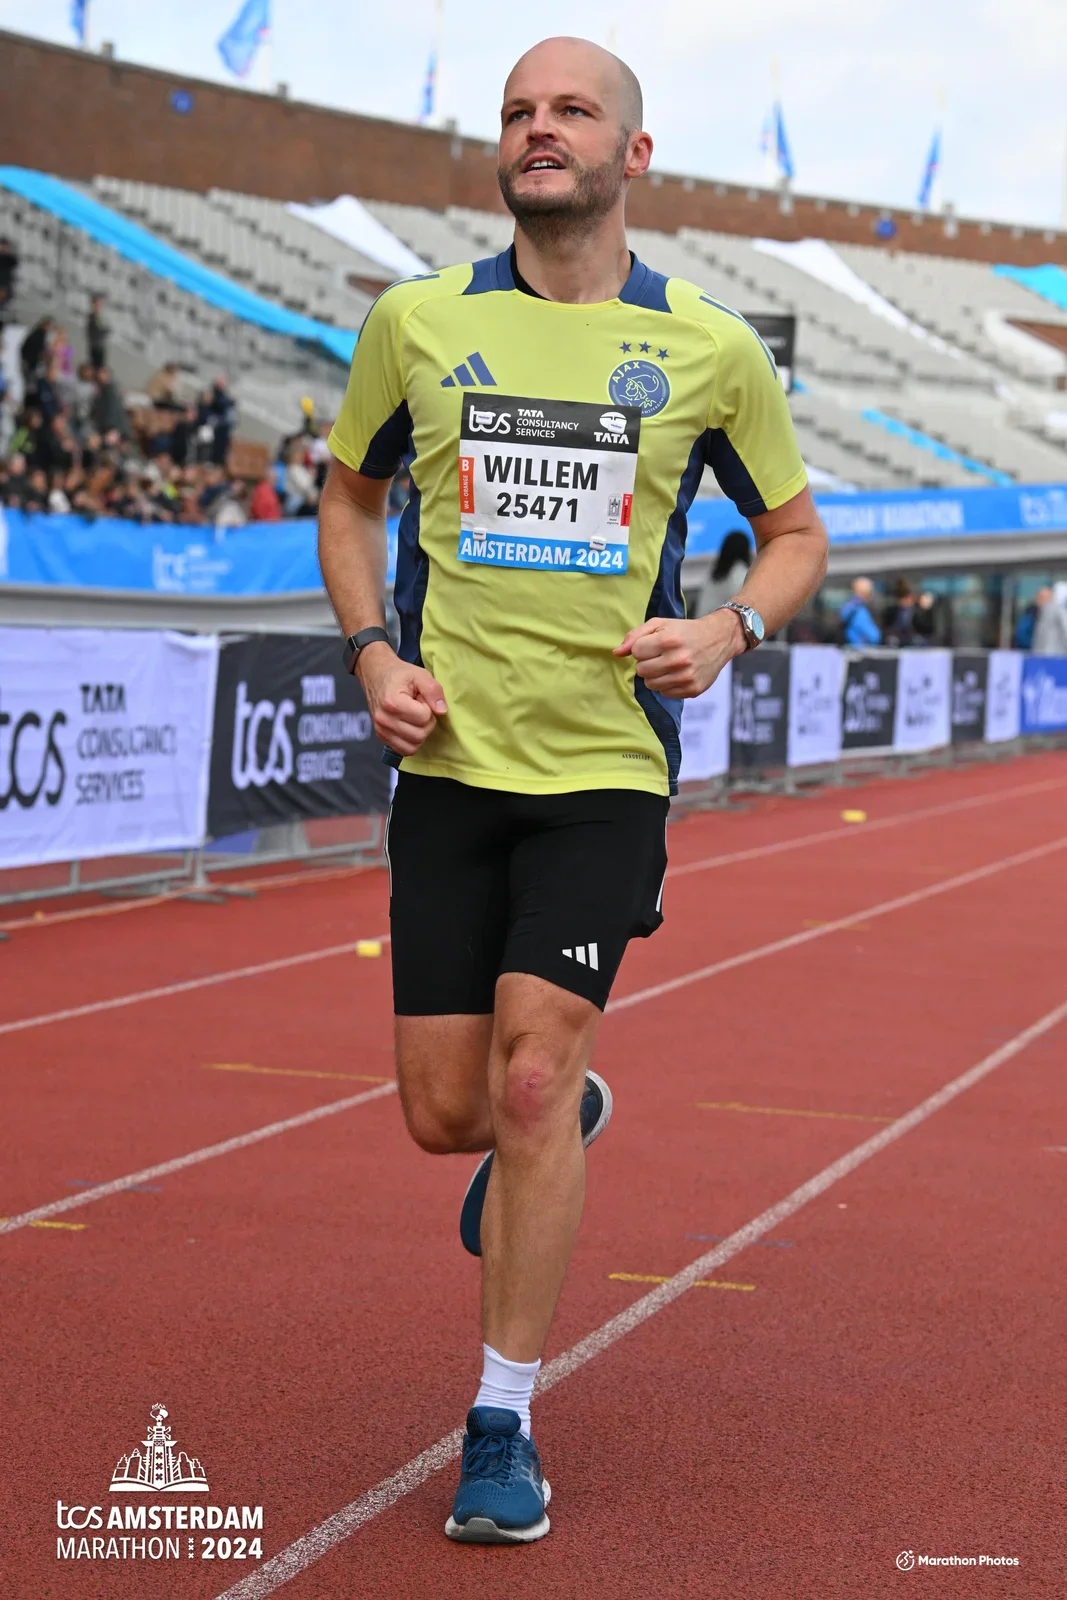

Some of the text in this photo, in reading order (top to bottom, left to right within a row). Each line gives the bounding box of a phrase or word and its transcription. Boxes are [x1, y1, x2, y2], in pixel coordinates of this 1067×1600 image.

[612, 361, 640, 384] AJAX
[469, 405, 511, 434] tcs
[516, 418, 579, 431] CONSULTANCY
[517, 409, 544, 418] TATA
[515, 428, 556, 439] SERVICES
[594, 432, 629, 445] TATA
[462, 459, 469, 471] B
[484, 455, 599, 490] WILLEM
[496, 492, 579, 523] 25471
[461, 537, 624, 569] AMSTERDAM 2024
[80, 683, 126, 714] TATA
[232, 680, 296, 789] tcs
